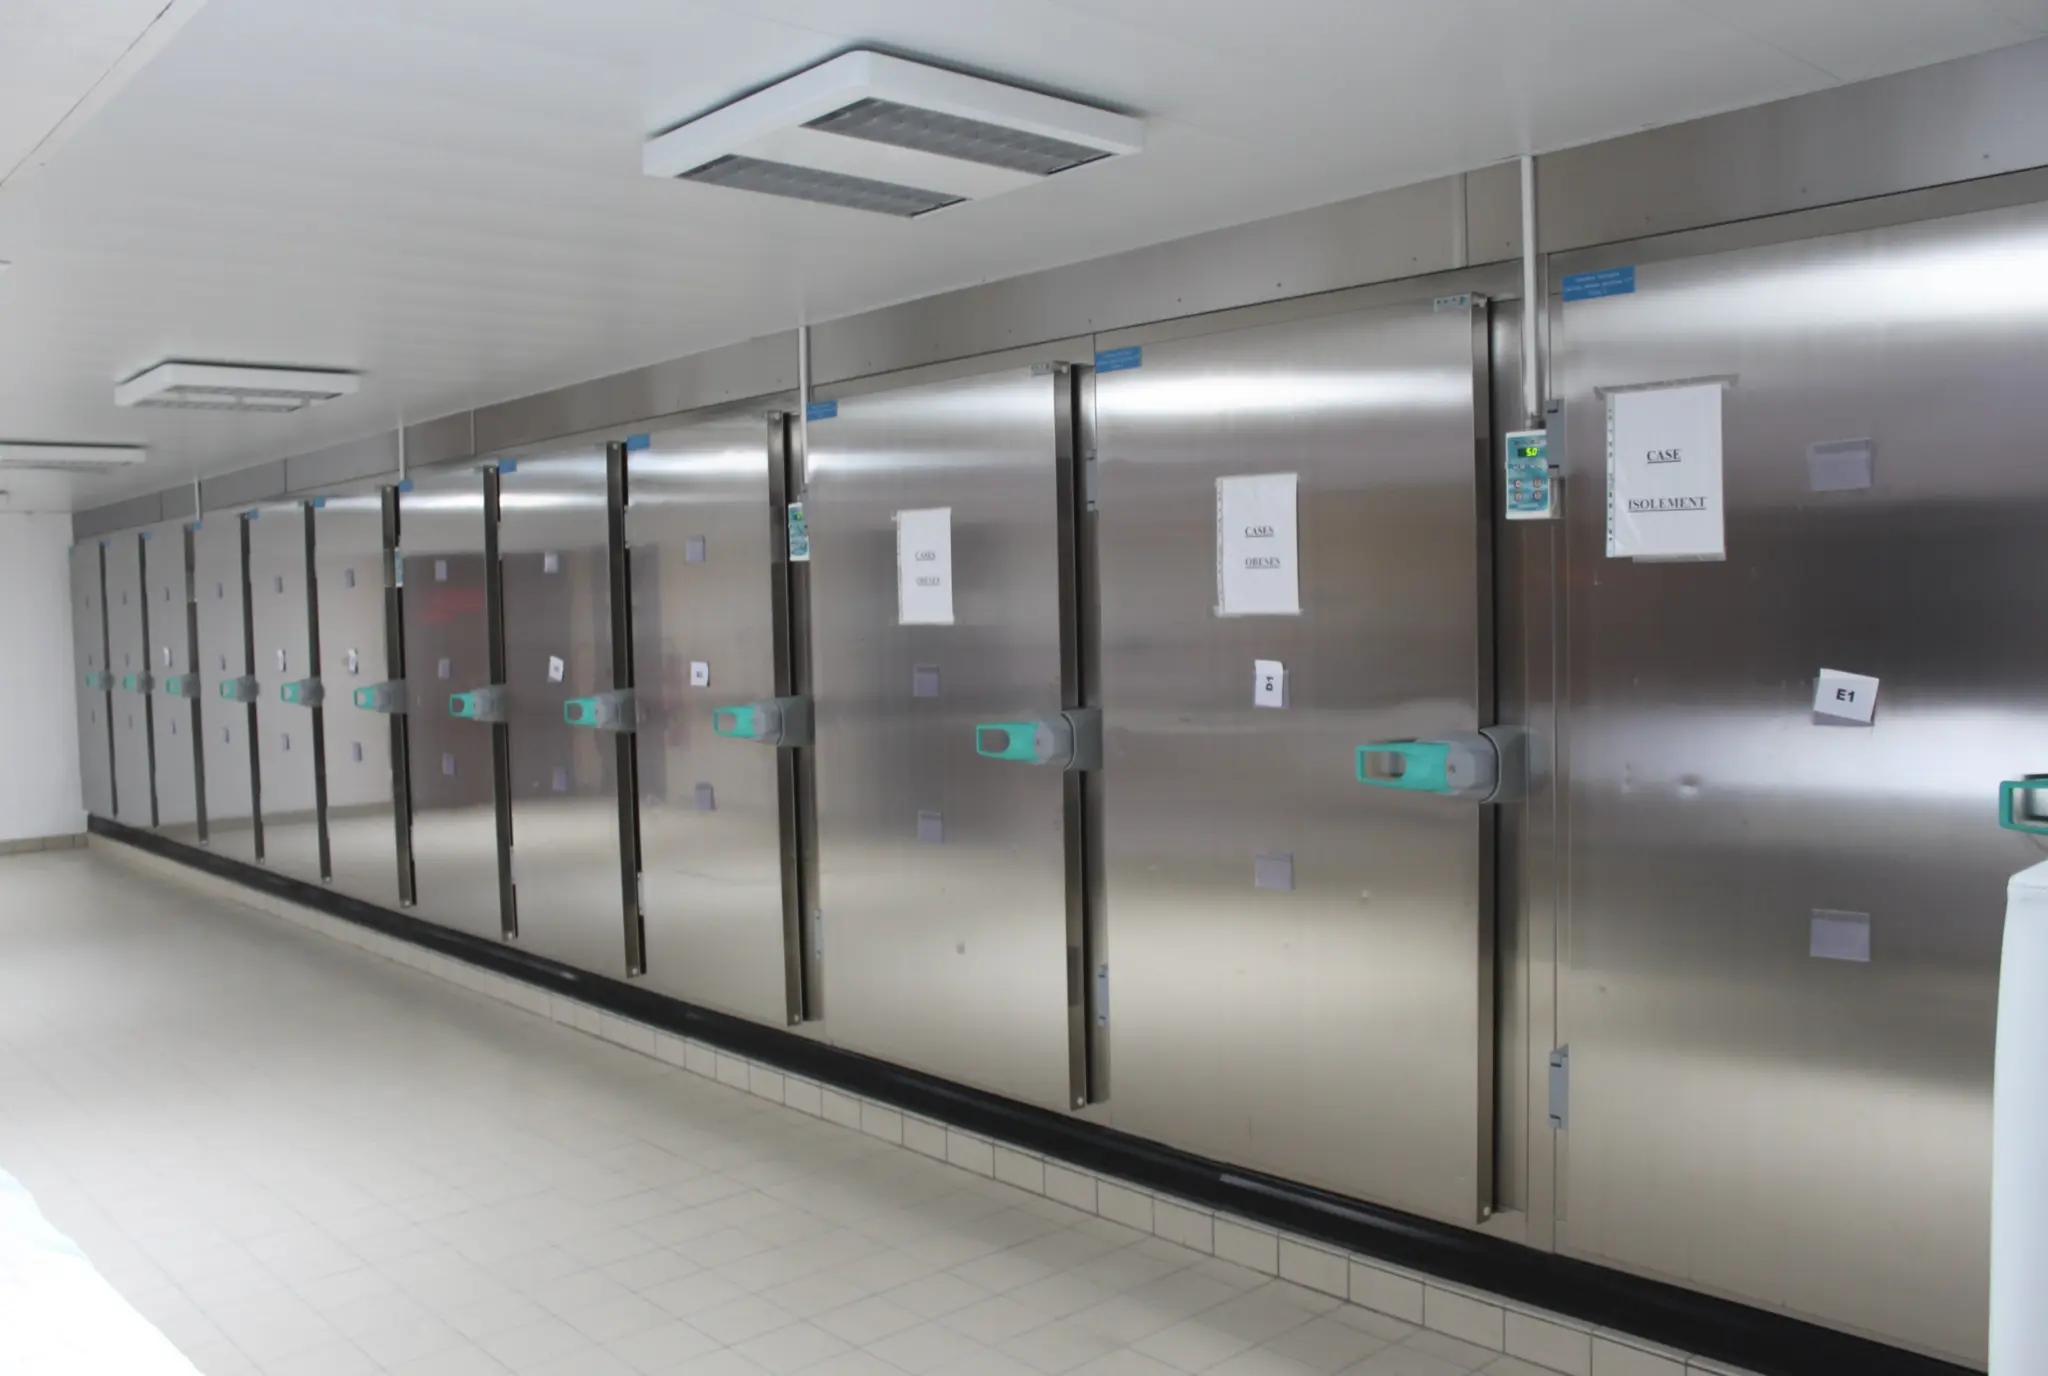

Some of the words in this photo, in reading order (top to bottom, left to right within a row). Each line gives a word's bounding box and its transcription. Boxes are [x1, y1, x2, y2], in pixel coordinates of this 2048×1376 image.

[1646, 448, 1682, 463] CASE
[1627, 496, 1707, 513] ISOLEMENT
[1245, 526, 1274, 538] CASES
[1265, 676, 1274, 691] D1
[1836, 688, 1855, 703] E1
